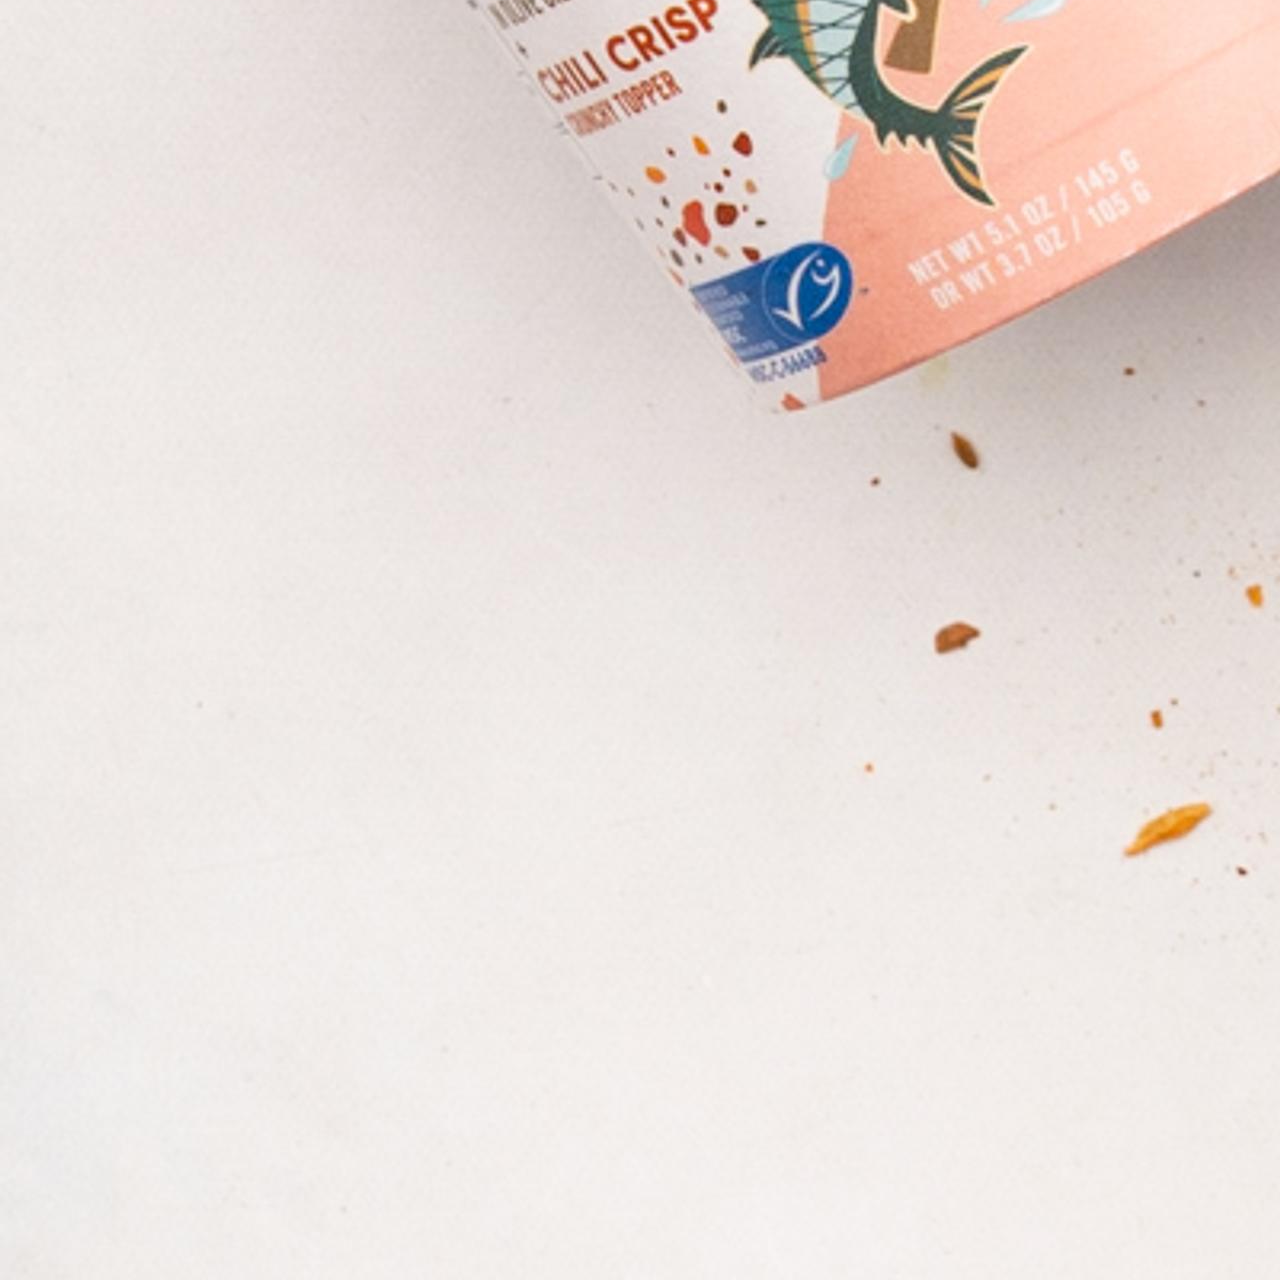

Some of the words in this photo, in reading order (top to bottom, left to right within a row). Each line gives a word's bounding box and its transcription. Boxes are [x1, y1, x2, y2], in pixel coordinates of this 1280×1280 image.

[536, 50, 609, 104] CHILI
[611, 69, 683, 117] TOPPER
[907, 248, 950, 287] NET
[946, 228, 986, 265] WT
[983, 212, 1022, 246] 5.1
[1020, 194, 1055, 227] OZ
[1058, 183, 1070, 213] /
[1074, 158, 1120, 199] 145
[1118, 147, 1142, 175] G
[929, 280, 964, 312] OR
[959, 260, 998, 296] WT
[995, 242, 1034, 278] 3.7
[1033, 225, 1068, 258] OZ
[1071, 213, 1083, 244] /
[1086, 189, 1132, 229] 105
[1130, 178, 1153, 206] G
